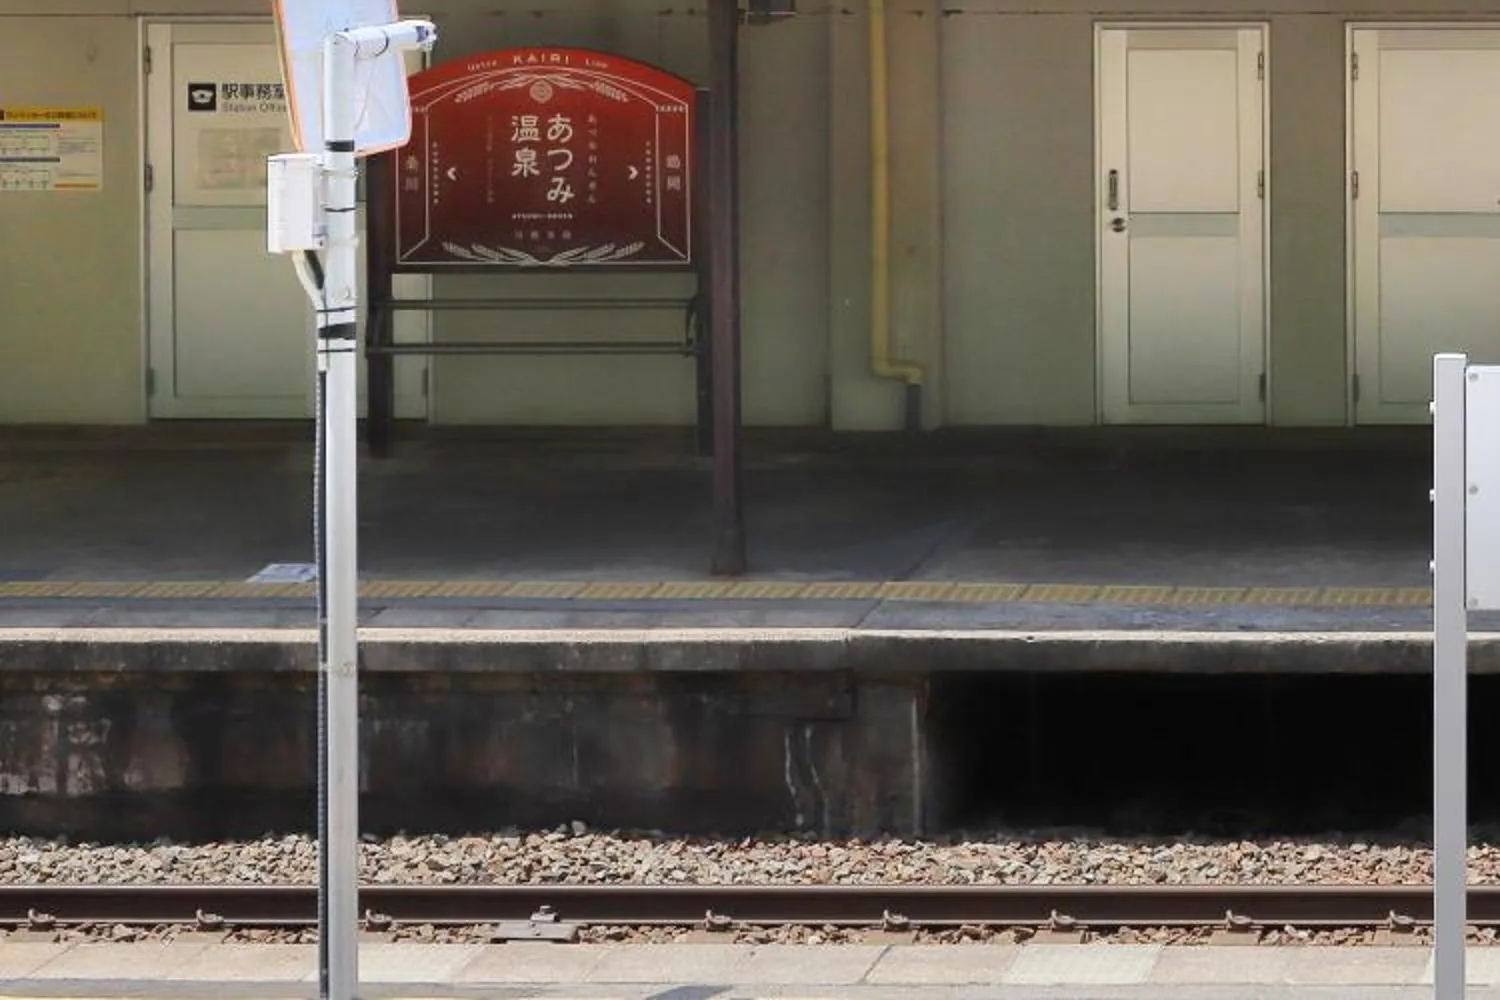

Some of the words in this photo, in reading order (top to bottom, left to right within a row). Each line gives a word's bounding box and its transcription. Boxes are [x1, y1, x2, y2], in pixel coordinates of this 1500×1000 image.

[513, 53, 569, 65] KAIRI
[222, 83, 285, 100] 駅事務室
[222, 103, 256, 113] Station
[511, 115, 541, 177] 温泉
[547, 113, 575, 203] あつみ
